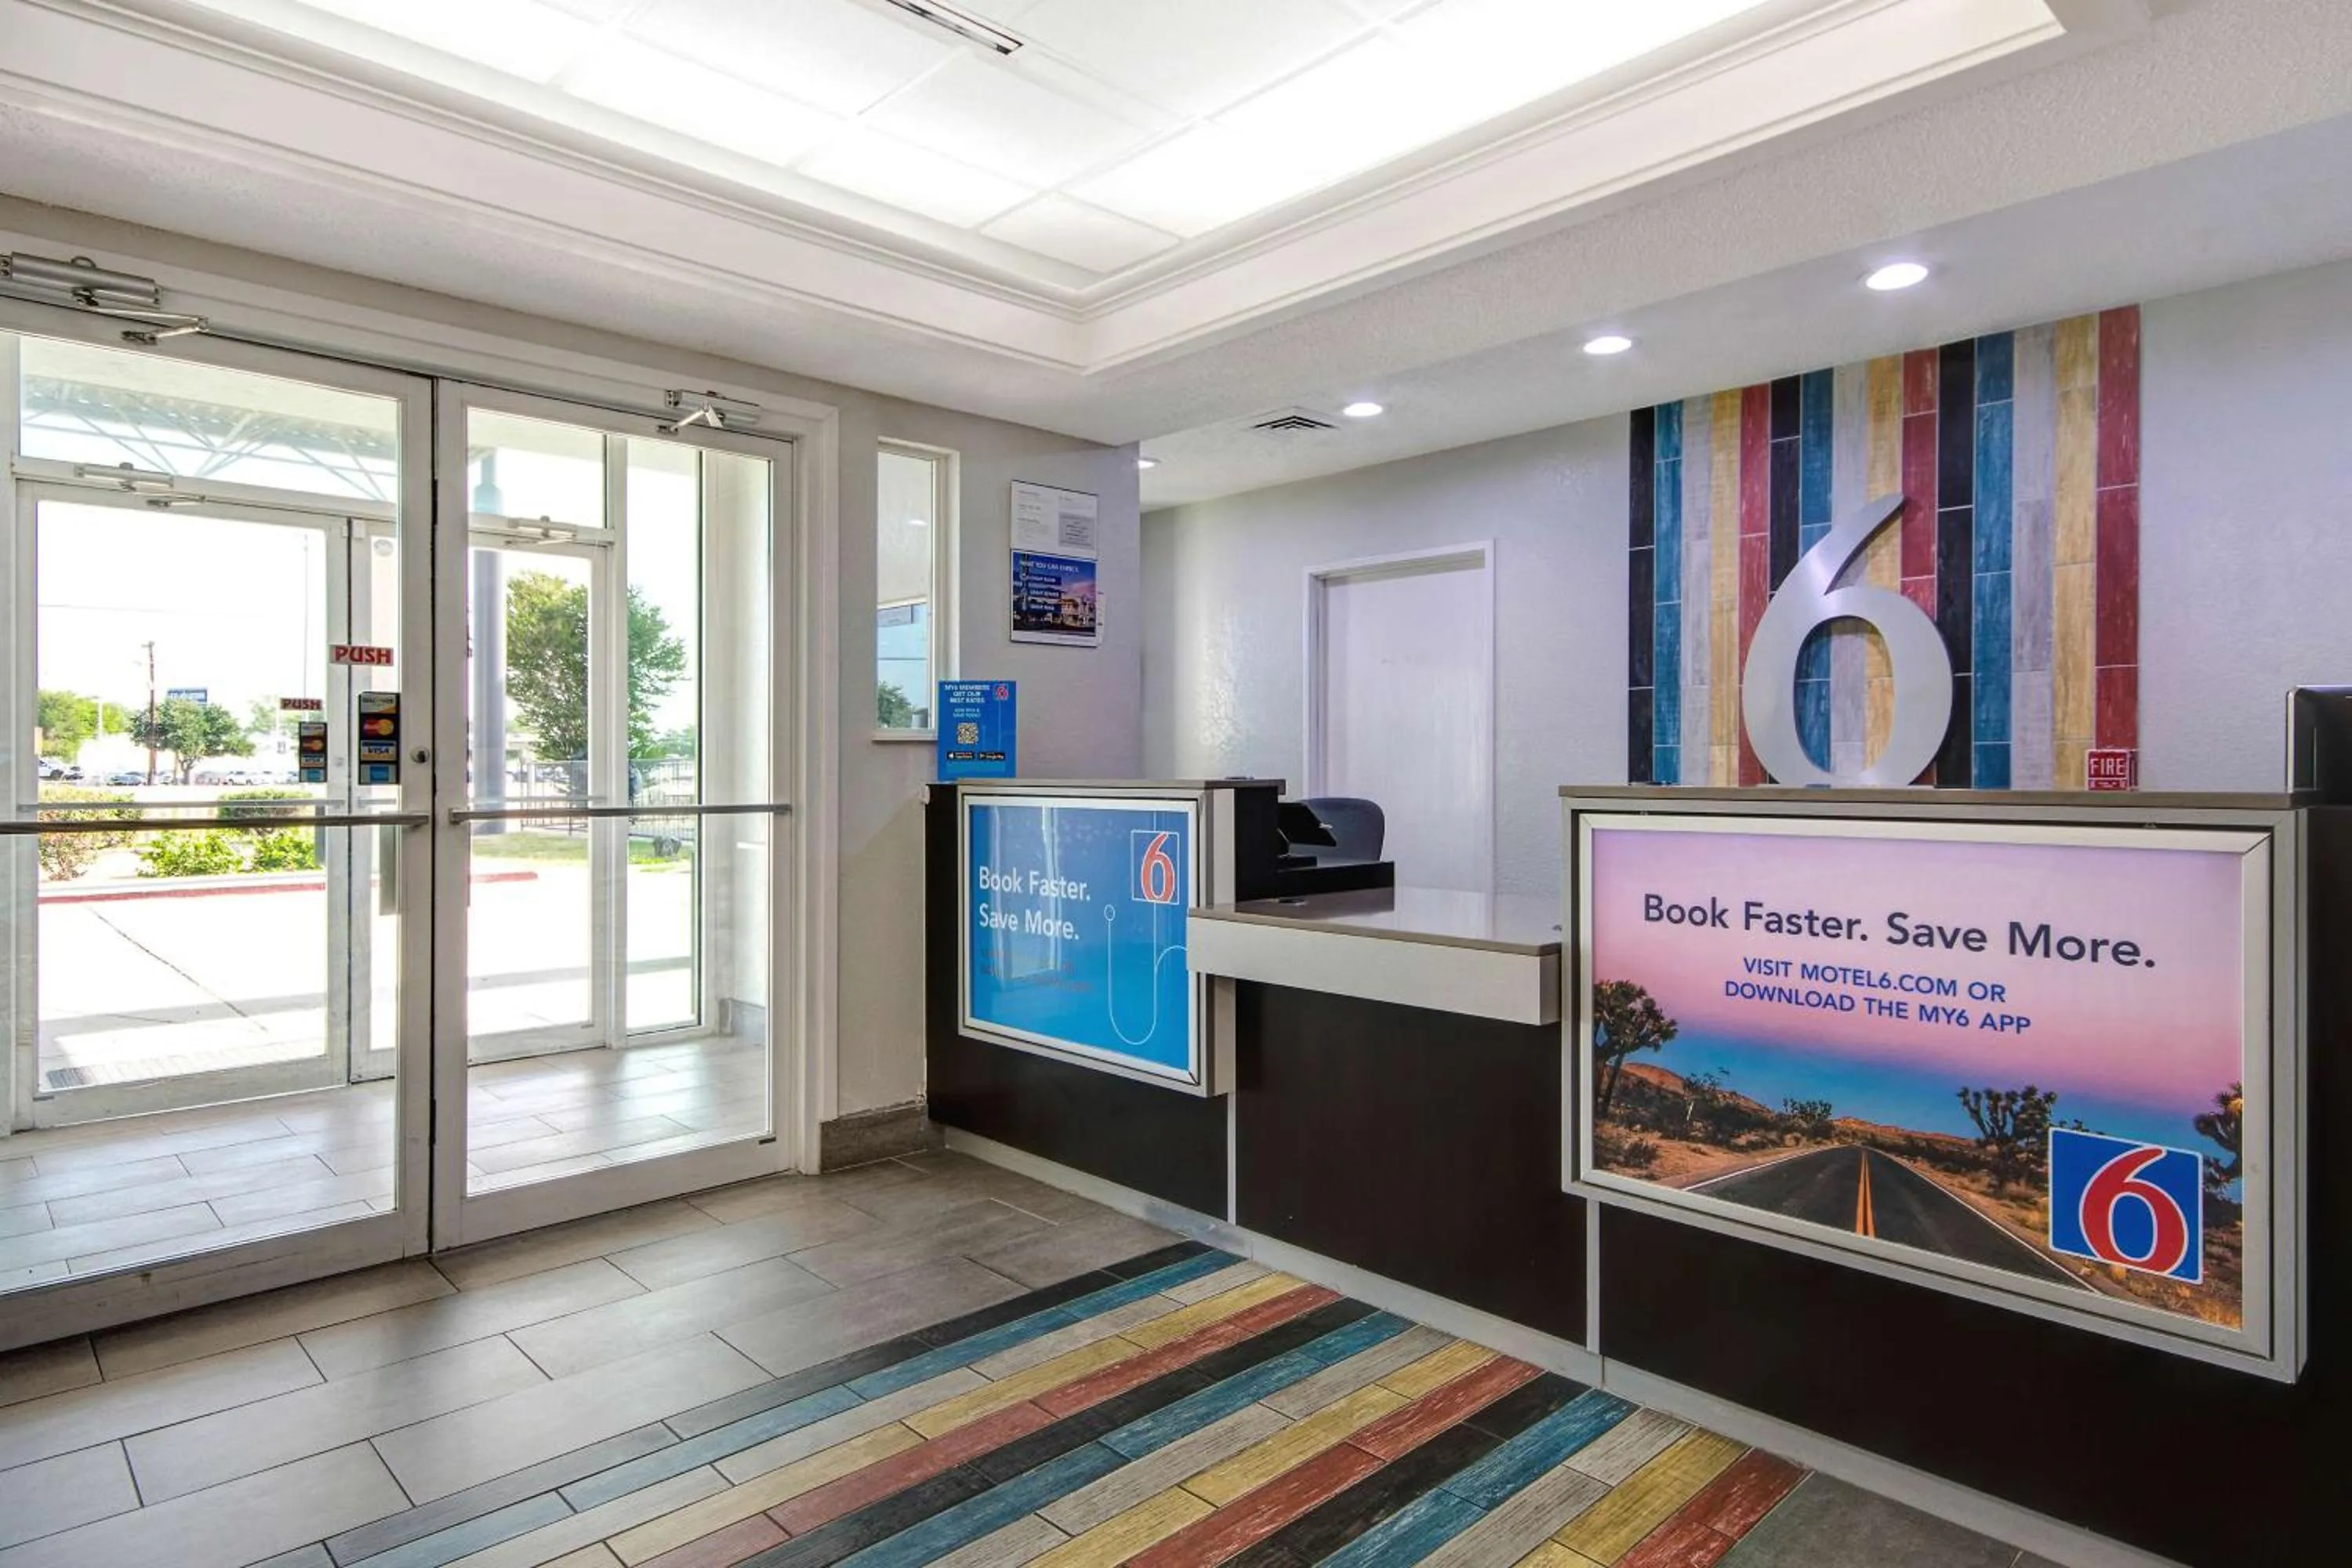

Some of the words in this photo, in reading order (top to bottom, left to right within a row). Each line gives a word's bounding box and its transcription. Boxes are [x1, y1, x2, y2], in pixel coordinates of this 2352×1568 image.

[335, 646, 391, 664] PUSH
[1742, 494, 1952, 785] 6
[281, 699, 322, 710] PUSH
[2090, 758, 2125, 775] FIRE
[979, 866, 1022, 893] Book
[1029, 870, 1091, 901] Faster.
[1141, 831, 1175, 902] 6
[979, 902, 1018, 931] Save
[1025, 909, 1080, 940] More.
[1644, 893, 1729, 928] Book
[1744, 902, 1868, 942] Faster.
[1886, 912, 1987, 952] Save
[2009, 921, 2155, 967] More.
[1744, 957, 1793, 977] VISIT
[1801, 963, 1957, 997] MOTEL6.COM
[1968, 982, 2006, 1003] OR
[1725, 981, 1855, 1011] DOWNLOAD
[1863, 997, 1908, 1019] THE
[1918, 1004, 1969, 1027] MY6
[1980, 1012, 2031, 1034] APP
[2079, 1145, 2189, 1275] 6
